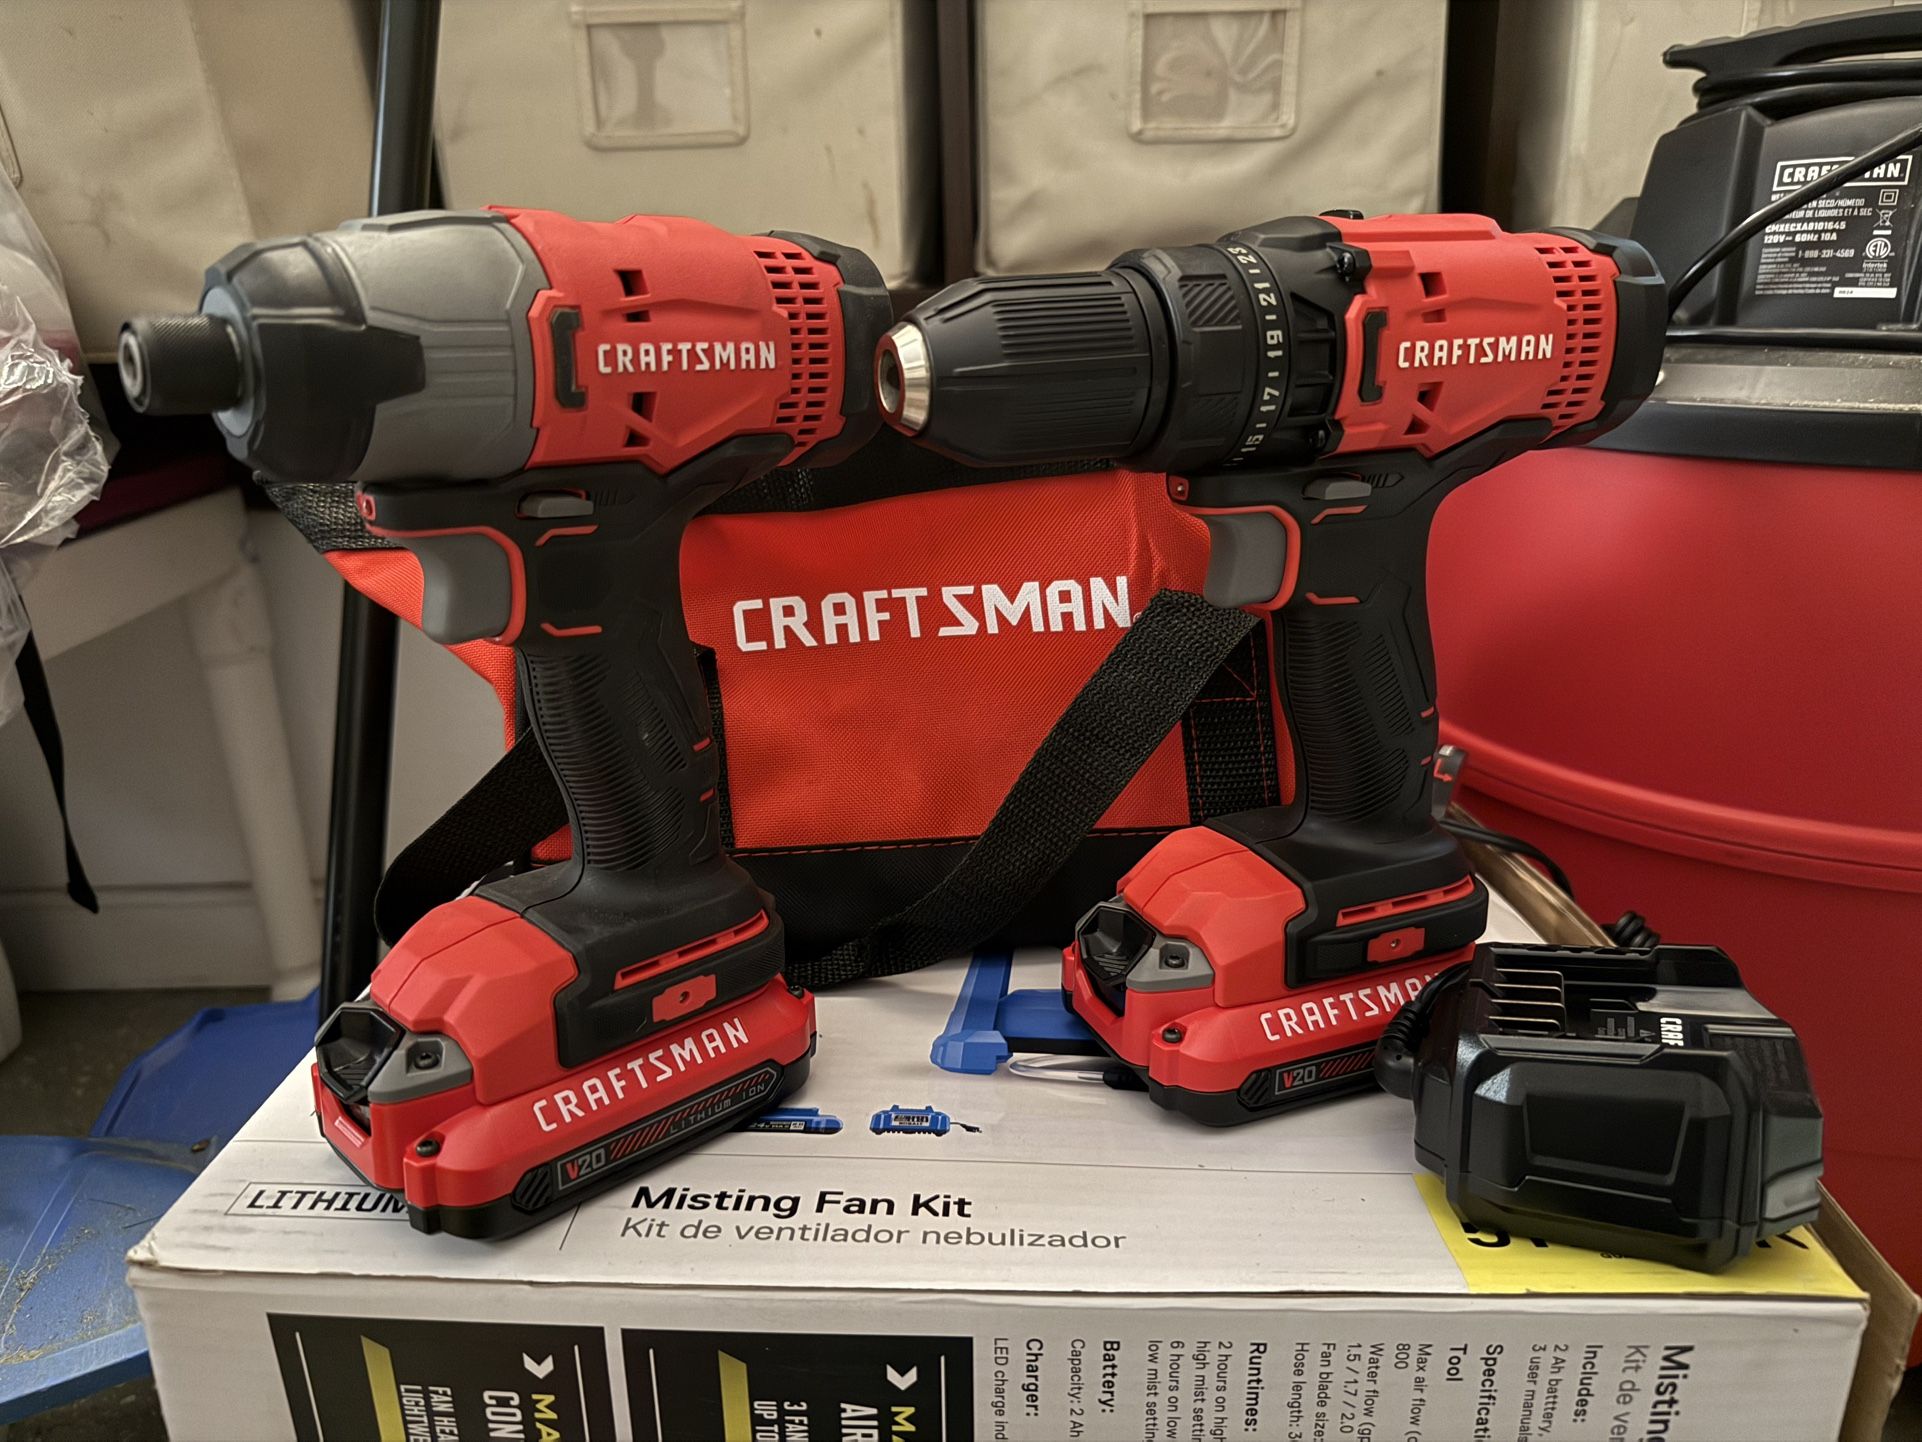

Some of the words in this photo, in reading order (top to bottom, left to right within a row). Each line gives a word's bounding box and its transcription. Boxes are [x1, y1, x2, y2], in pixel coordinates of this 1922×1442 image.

[1782, 162, 1902, 184] CRAFAN
[1820, 231, 1838, 241] 10A
[1253, 281, 1277, 306] 21
[597, 340, 776, 374] CRAFTSMAN
[1266, 329, 1283, 358] 19
[1397, 333, 1553, 369] CRAFTSMAN
[1260, 387, 1280, 411] 17
[732, 575, 1132, 652] CRAFTSMAN
[532, 1017, 749, 1132] CRAFTSMAN
[1283, 1065, 1316, 1089] V20
[565, 1149, 606, 1181] V20
[631, 1186, 801, 1219] Misting
[815, 1190, 896, 1216] Fan
[911, 1193, 973, 1218] Kit
[620, 1216, 670, 1238] Kit
[679, 1218, 723, 1240] de
[734, 1221, 911, 1244] ventilador
[921, 1226, 1127, 1249] nebulizador
[994, 1337, 1009, 1366] LED
[1147, 1340, 1163, 1364] low
[1170, 1340, 1185, 1349] 6
[1192, 1340, 1212, 1370] high
[1218, 1341, 1233, 1350] 2
[1320, 1342, 1336, 1367] Fan
[1346, 1342, 1362, 1362] 1.5
[1394, 1342, 1411, 1370] 800
[1416, 1343, 1433, 1372] Max
[1531, 1343, 1547, 1352] 3
[1553, 1343, 1569, 1352] 2
[1067, 1338, 1086, 1404] Capacity:
[1168, 1353, 1185, 1392] hours
[1215, 1353, 1232, 1392] hours
[1292, 1342, 1310, 1377] Hose
[1366, 1342, 1385, 1384] Water
[1445, 1343, 1468, 1381] Tool
[1526, 1356, 1542, 1385] user
[1550, 1356, 1567, 1374] Ah
[1621, 1345, 1651, 1374] Kit
[1021, 1338, 1044, 1417] Charger:
[1097, 1340, 1121, 1413] Battery:
[1146, 1368, 1161, 1397] mist
[1193, 1374, 1209, 1403] mist
[1244, 1342, 1268, 1432] Runtimes:
[1316, 1371, 1334, 1408] blade
[1344, 1378, 1359, 1397] 1.7
[1413, 1376, 1428, 1394] air
[1572, 1344, 1604, 1423] Includes:
[428, 1385, 455, 1412] FAN
[783, 1401, 808, 1411] 3
[990, 1370, 1009, 1417] charge
[1167, 1395, 1179, 1412] on
[1214, 1395, 1226, 1412] on
[1287, 1381, 1307, 1427] length:
[1363, 1389, 1379, 1418] flow
[1473, 1343, 1504, 1442] Specificati
[1615, 1379, 1642, 1405] de
[753, 1400, 778, 1420] UP
[1069, 1407, 1085, 1417] 2
[1142, 1401, 1159, 1442] settin
[1339, 1412, 1355, 1434] 2.0
[1409, 1398, 1426, 1426] flow
[1069, 1420, 1085, 1438] Ah
[1166, 1416, 1182, 1439] low
[1209, 1416, 1228, 1442] high
[1313, 1411, 1330, 1442] size:
